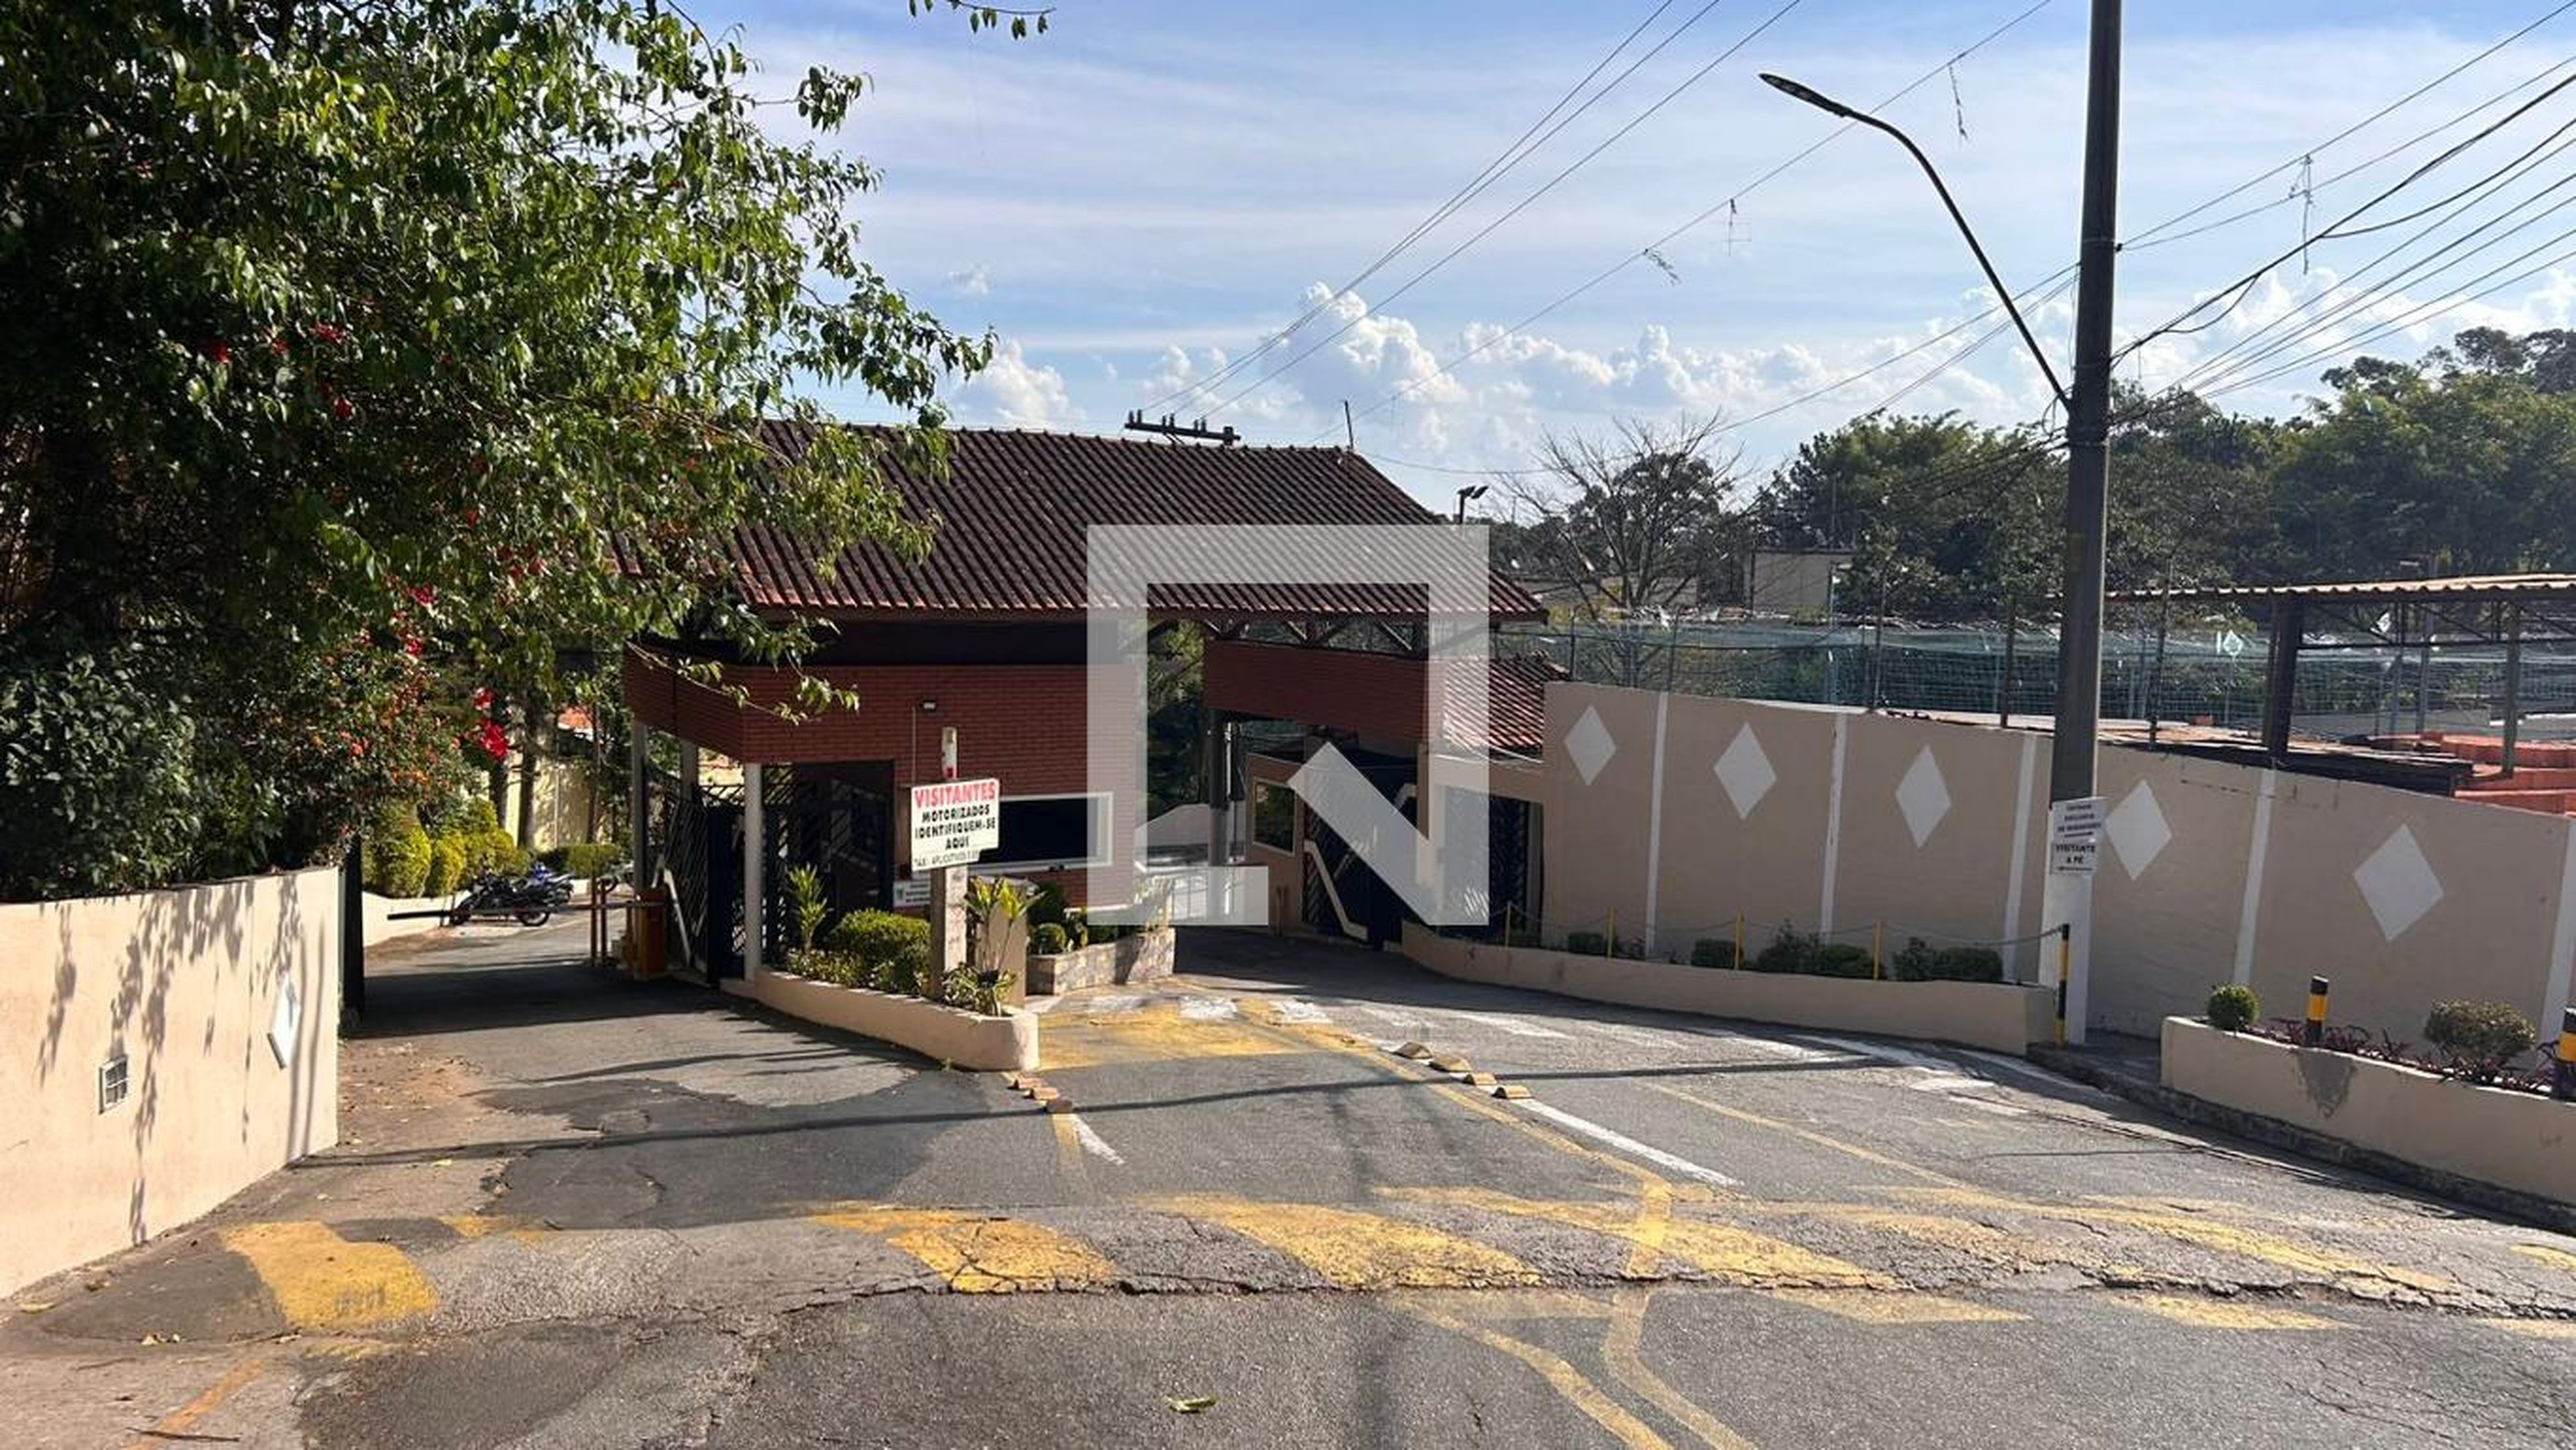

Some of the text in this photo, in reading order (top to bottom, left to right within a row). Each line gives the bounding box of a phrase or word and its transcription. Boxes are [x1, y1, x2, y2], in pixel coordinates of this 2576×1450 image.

[914, 782, 996, 809] VISITANTES
[922, 804, 990, 823] MOTORIZADOS
[915, 817, 996, 839] IDENTIFIQUEM-SE
